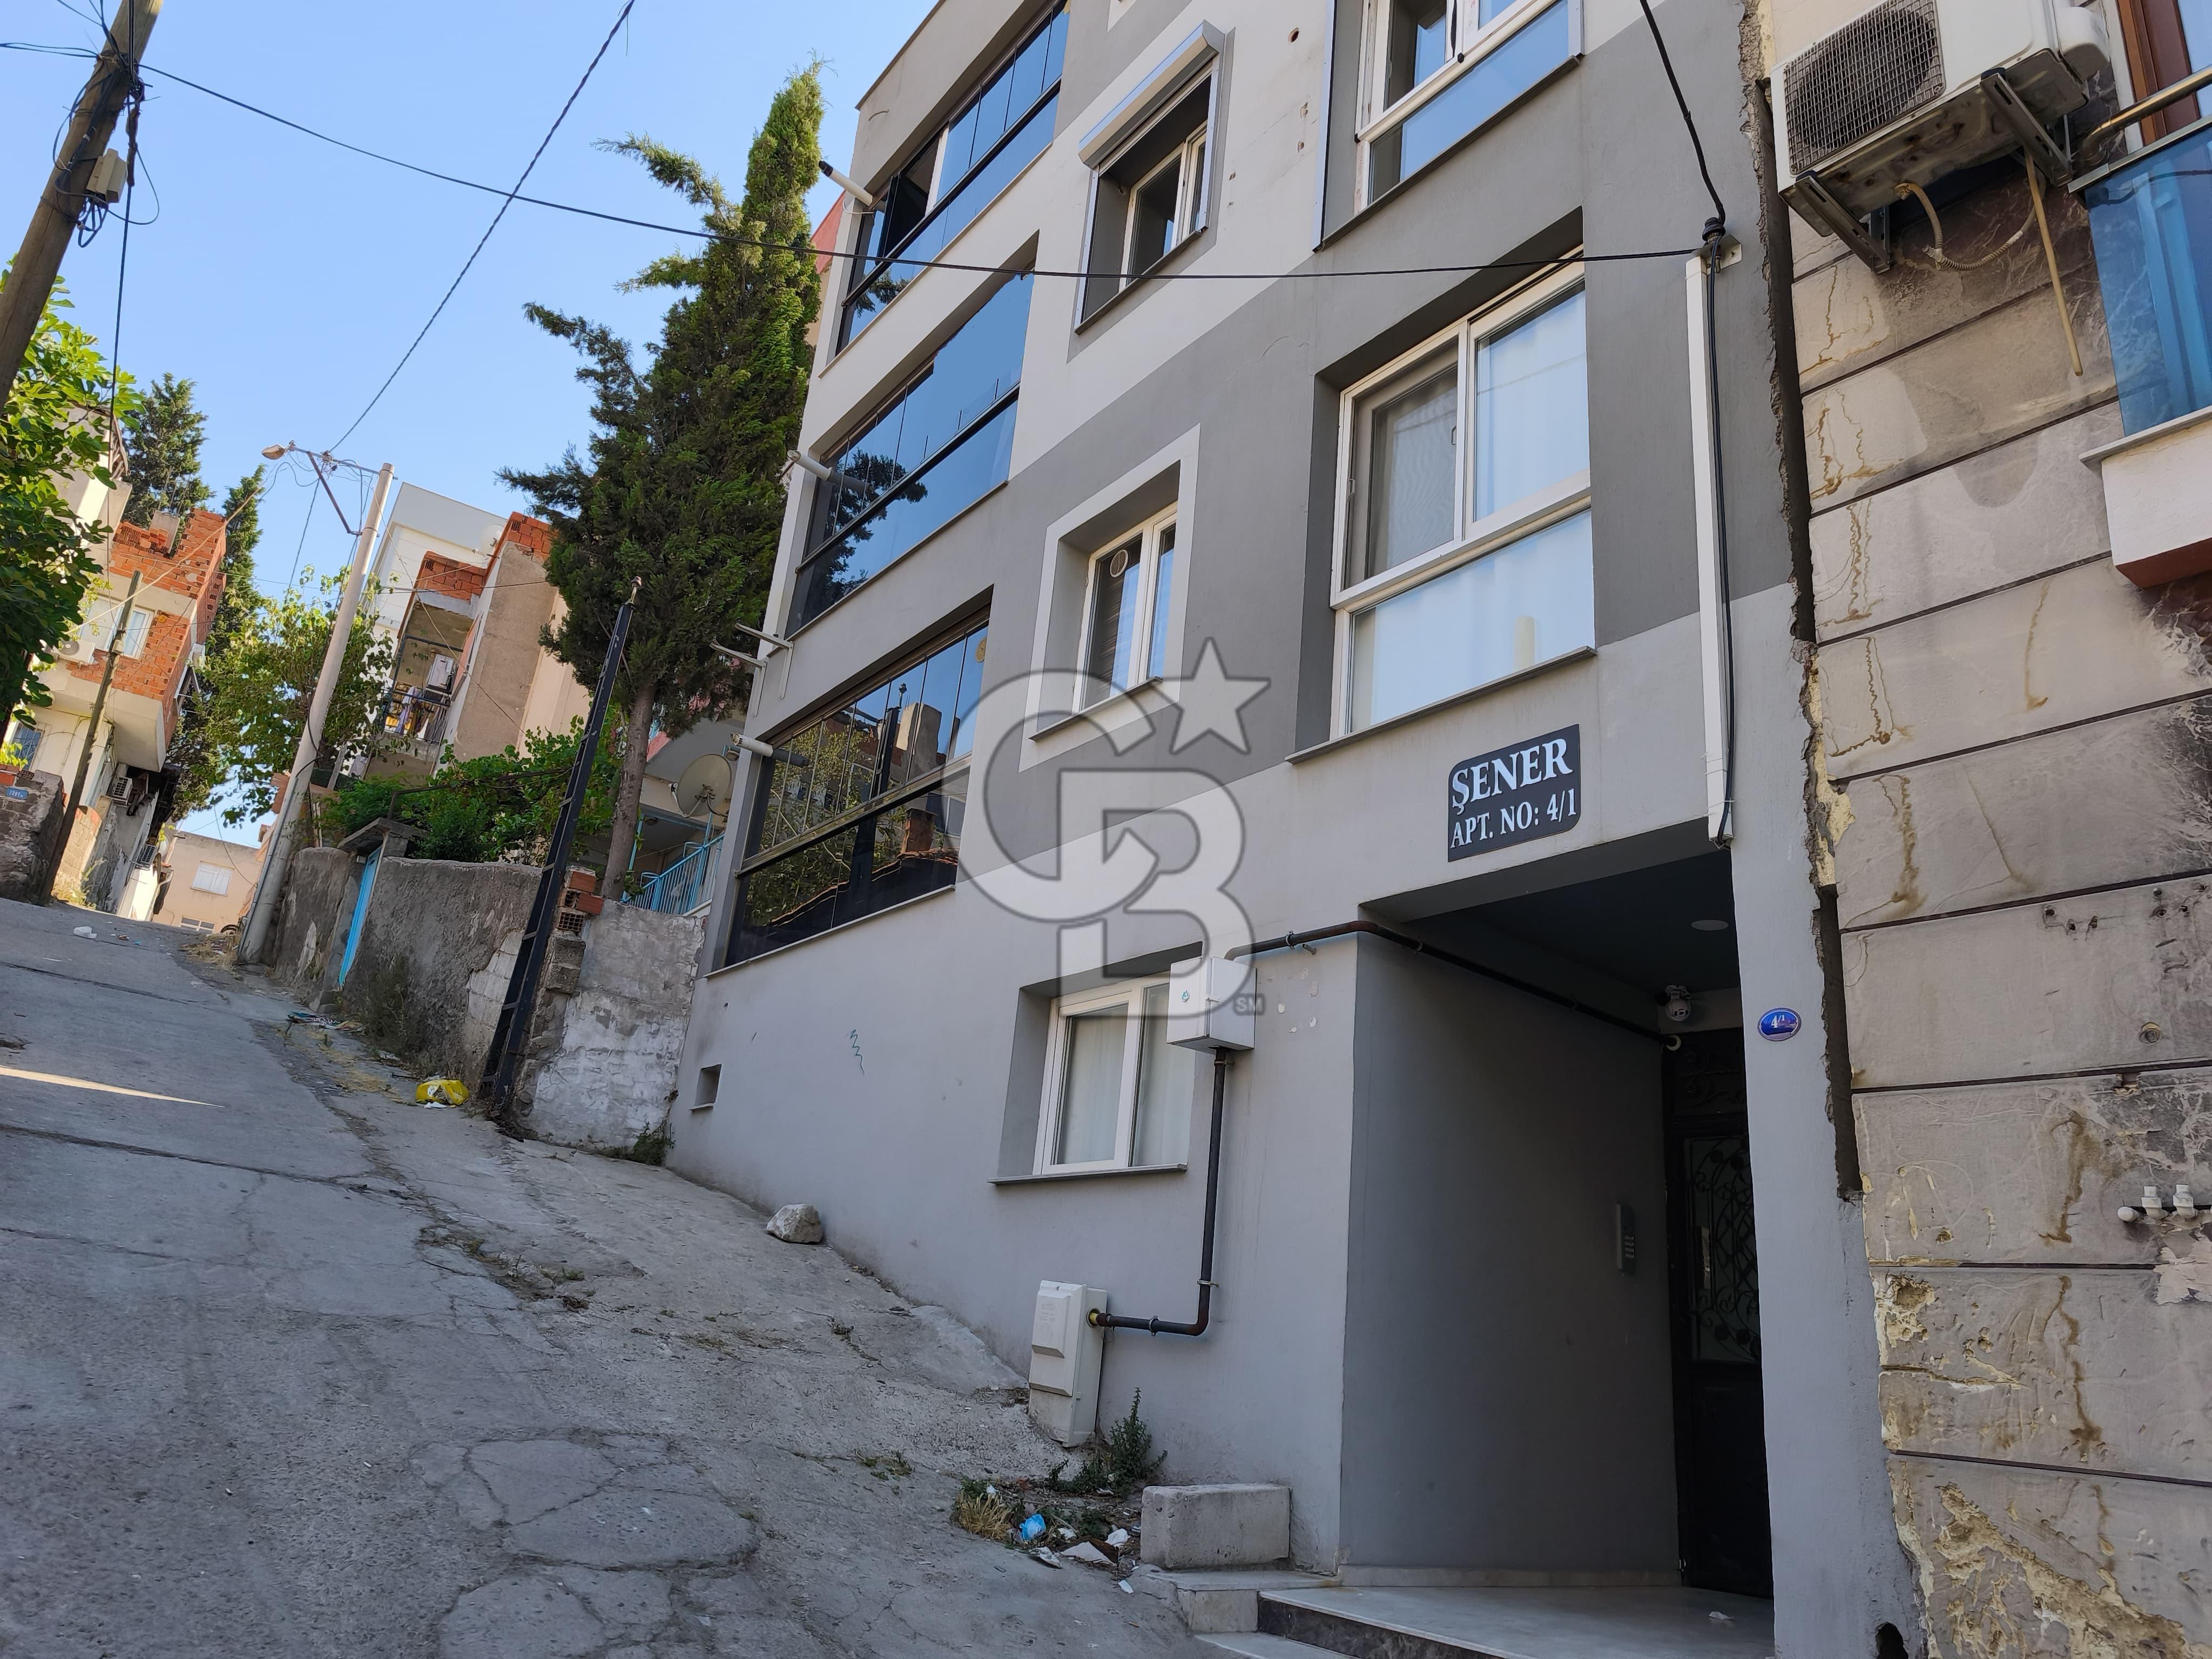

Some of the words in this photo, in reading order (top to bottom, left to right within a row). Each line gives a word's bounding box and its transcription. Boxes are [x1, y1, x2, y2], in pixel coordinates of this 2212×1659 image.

[1452, 738, 1573, 815] ŞENER
[1449, 812, 1493, 849] APT.
[1500, 801, 1539, 835] NO:
[1546, 788, 1577, 823] 4/1
[1771, 1014, 1785, 1028] 4/1
